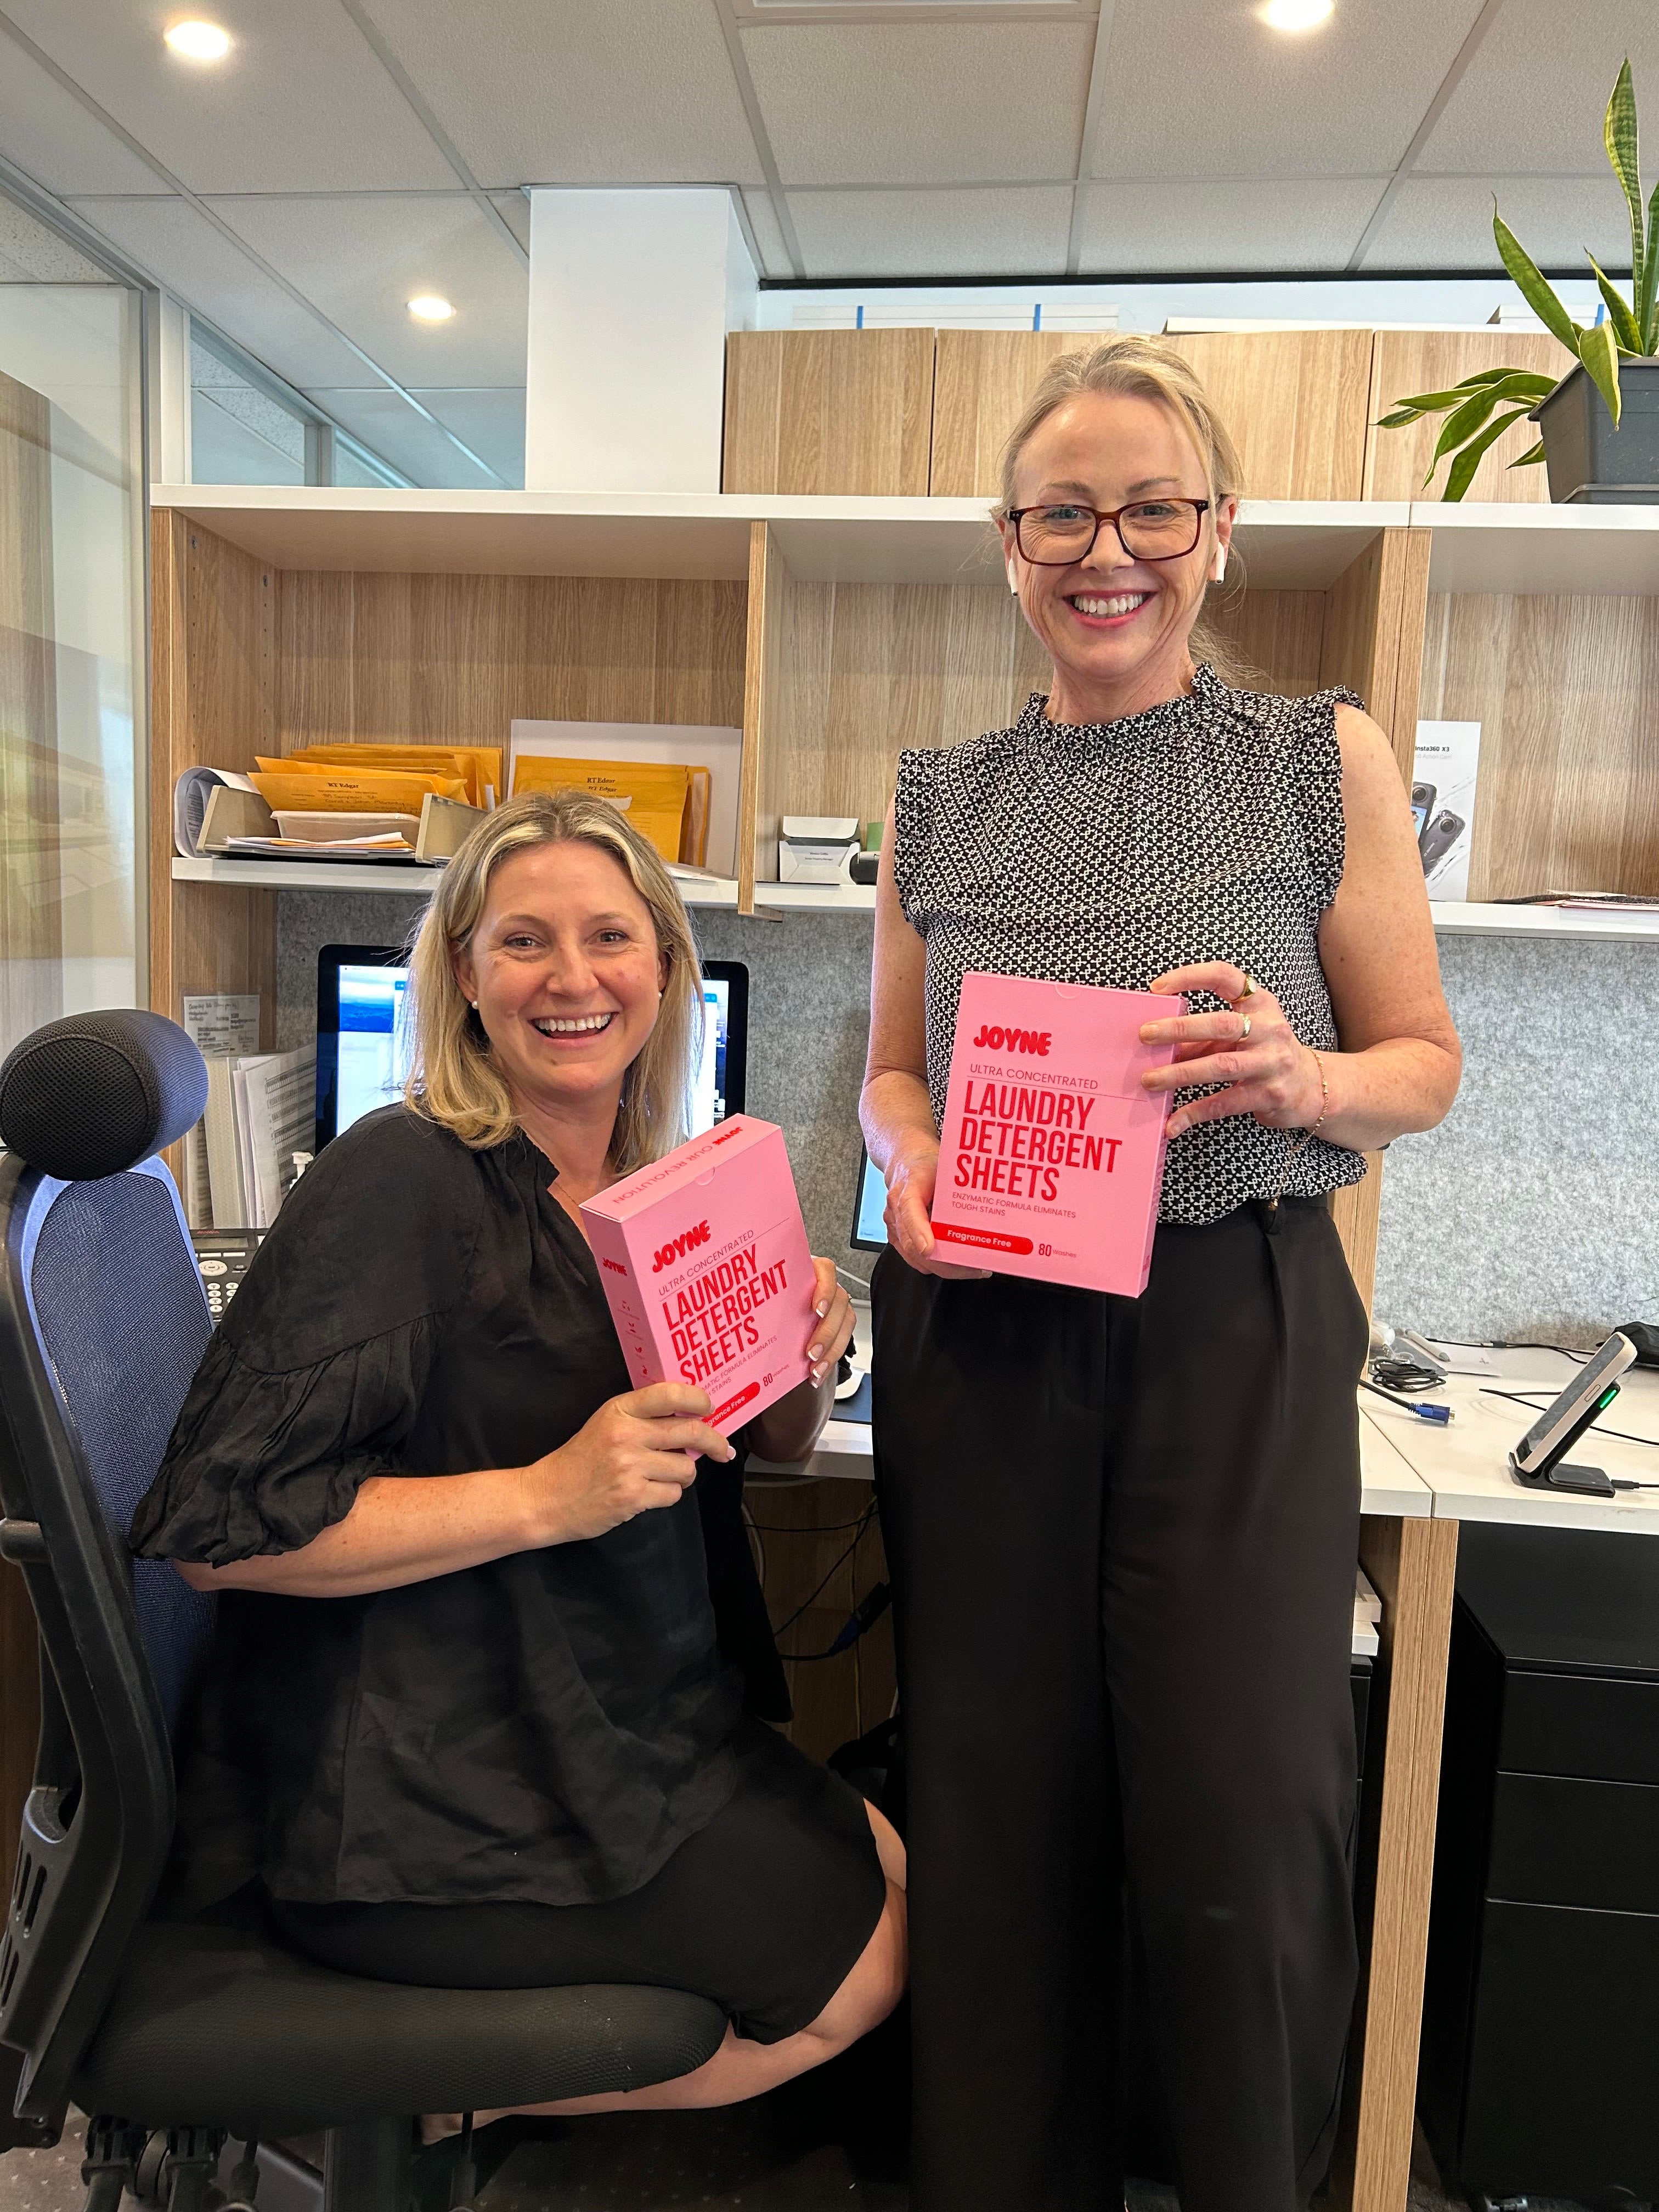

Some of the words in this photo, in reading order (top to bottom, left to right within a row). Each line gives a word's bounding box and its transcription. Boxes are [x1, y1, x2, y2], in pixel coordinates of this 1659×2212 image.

[974, 1025, 1052, 1057] JOYNE
[970, 1063, 1003, 1077] ULTRA
[1006, 1069, 1098, 1090] CONCENTRATED
[964, 1080, 1096, 1131] LAUNDRY
[713, 1126, 743, 1146] JOYNE
[959, 1116, 1122, 1173] DETERGENT
[686, 1146, 713, 1161] OUR
[612, 1161, 688, 1204] REVOLUTION
[954, 1153, 1059, 1201] SHEETS
[952, 1192, 994, 1204] ENZYMATIC
[996, 1199, 1031, 1211] FORMULA
[1033, 1205, 1076, 1218] ELIMINATES
[952, 1201, 978, 1211] TOUGH
[980, 1206, 1006, 1216] STAINS
[652, 1219, 712, 1273] JOYNE
[947, 1229, 992, 1244] Fragrance
[992, 1238, 1012, 1248] Free
[1039, 1243, 1052, 1257] 80
[602, 1257, 628, 1277] JOYNE
[658, 1274, 686, 1296] ULTRA
[686, 1229, 754, 1277] CONCENTRATED
[662, 1243, 759, 1331] LAUNDRY
[670, 1259, 788, 1362] DETERGENT
[680, 1316, 759, 1386] SHEETS
[721, 1357, 747, 1378] FORMULA
[748, 1335, 778, 1360] ELIMINATES
[712, 1377, 731, 1394] STAINS
[763, 1373, 773, 1387] 80
[731, 1395, 746, 1409] Free
